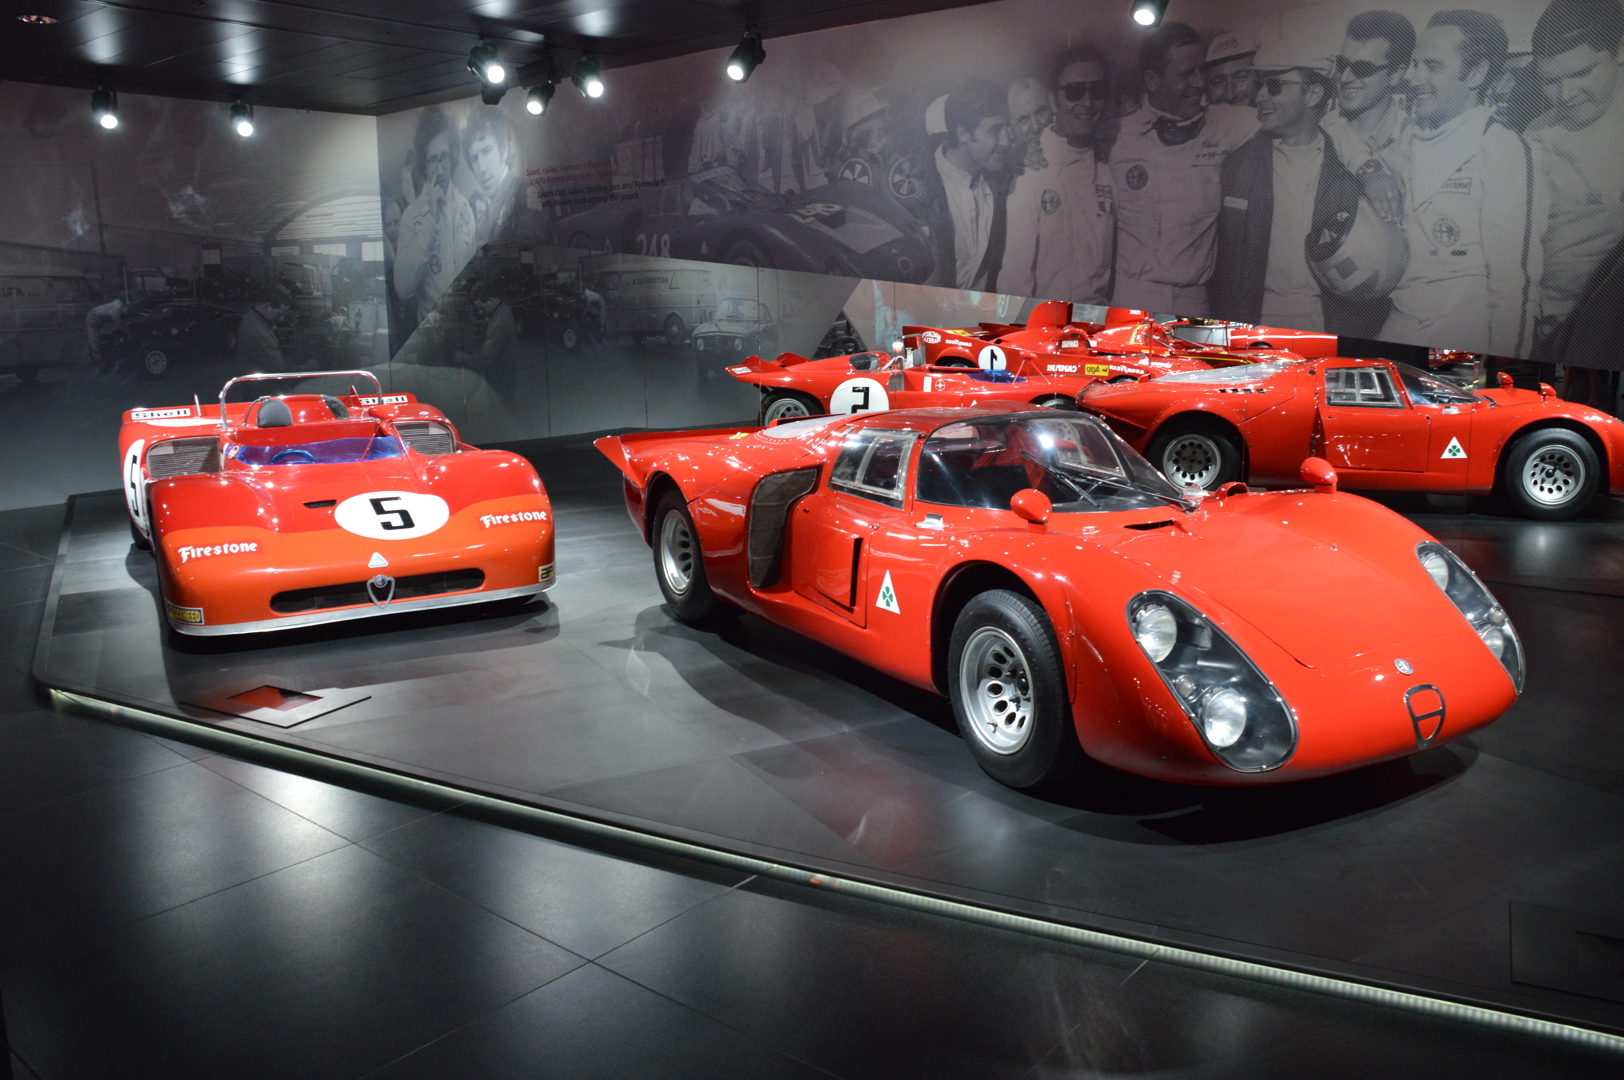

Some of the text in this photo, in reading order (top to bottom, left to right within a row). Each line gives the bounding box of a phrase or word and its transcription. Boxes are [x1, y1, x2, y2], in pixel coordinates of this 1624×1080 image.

[537, 190, 554, 199] Sports
[586, 186, 608, 194] touring
[608, 184, 620, 192] cars
[622, 182, 634, 190] and
[634, 180, 660, 188] Formula
[609, 193, 620, 202] the
[637, 233, 671, 258] 248
[134, 409, 188, 419] Shell
[130, 453, 139, 517] 5
[368, 496, 416, 531] 5
[479, 508, 548, 529] Firestone
[177, 540, 258, 563] Firestone
